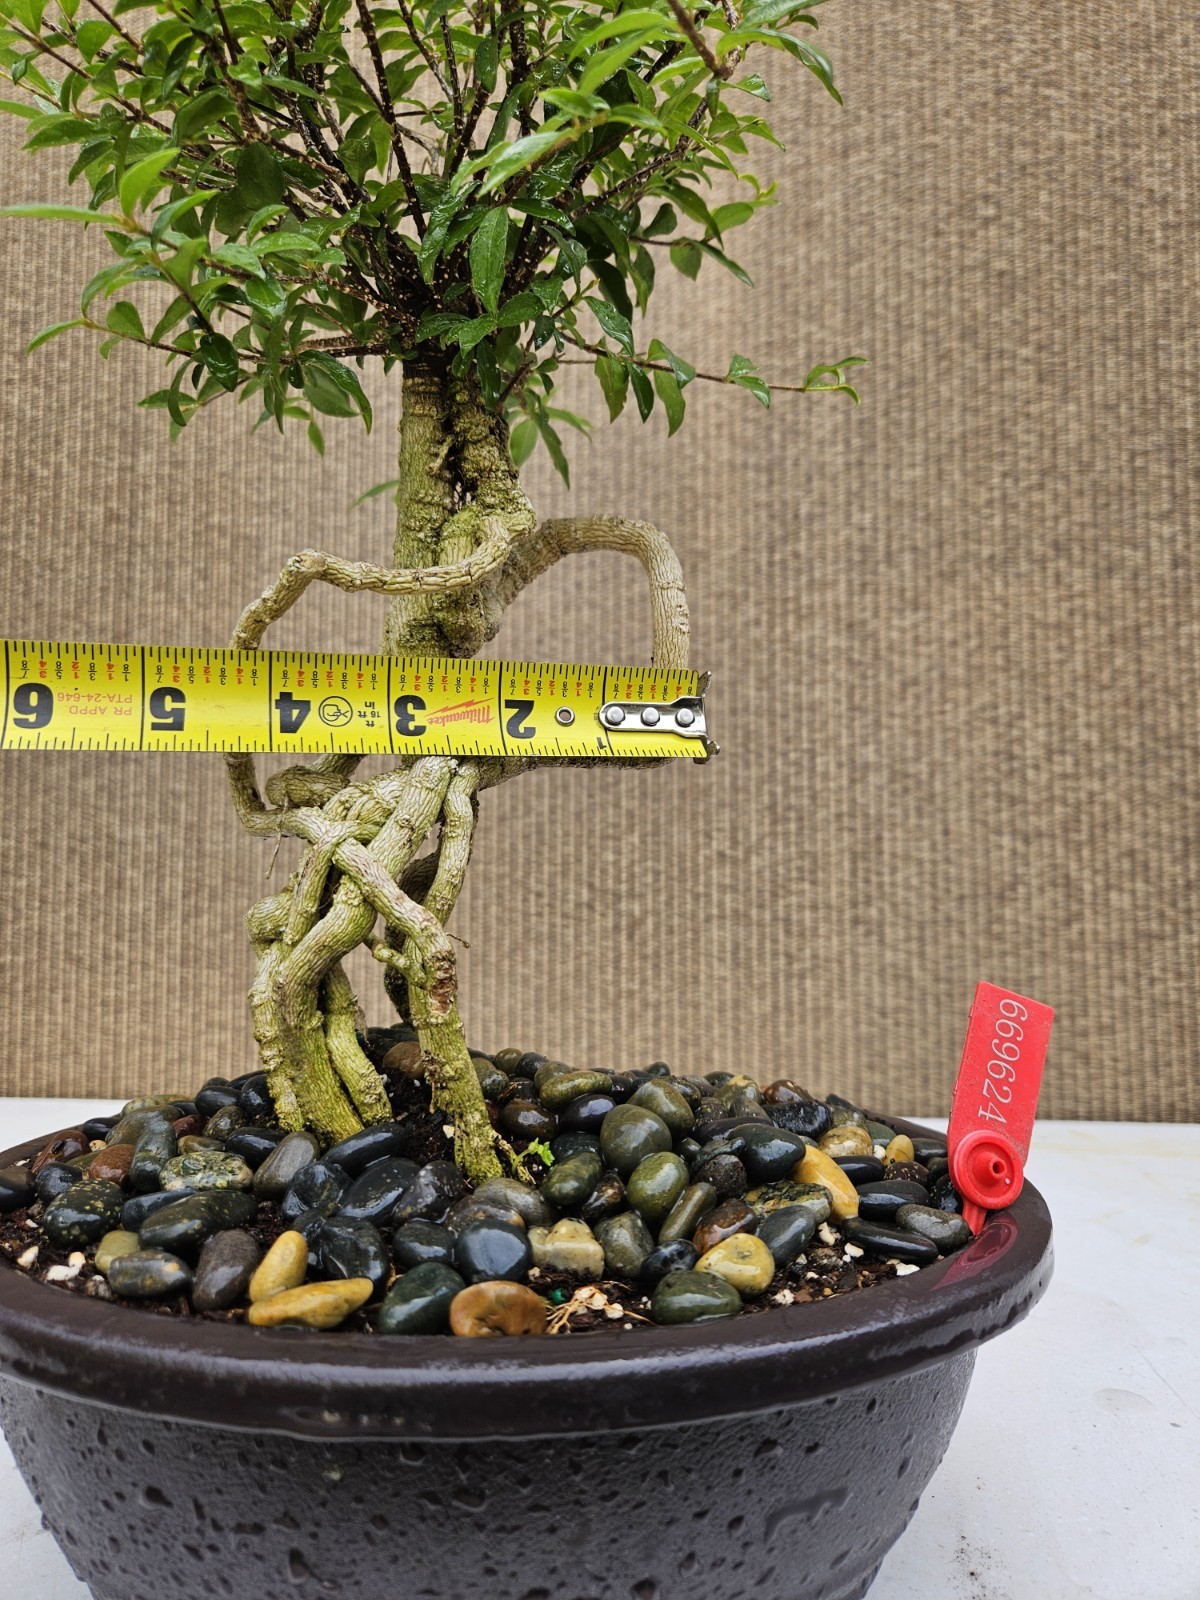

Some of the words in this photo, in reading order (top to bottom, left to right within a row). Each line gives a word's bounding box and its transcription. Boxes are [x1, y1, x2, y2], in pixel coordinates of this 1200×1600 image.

[13, 682, 54, 729] 6
[57, 692, 133, 704] PTA-24-646
[69, 705, 107, 715] APPD
[114, 706, 133, 716] PR
[149, 686, 186, 731] 5
[275, 692, 311, 734] 4
[394, 694, 426, 737] 3
[427, 704, 495, 727] Milwaukee
[504, 699, 536, 739] 2
[596, 737, 607, 750] 1
[978, 999, 1028, 1124] 669624
